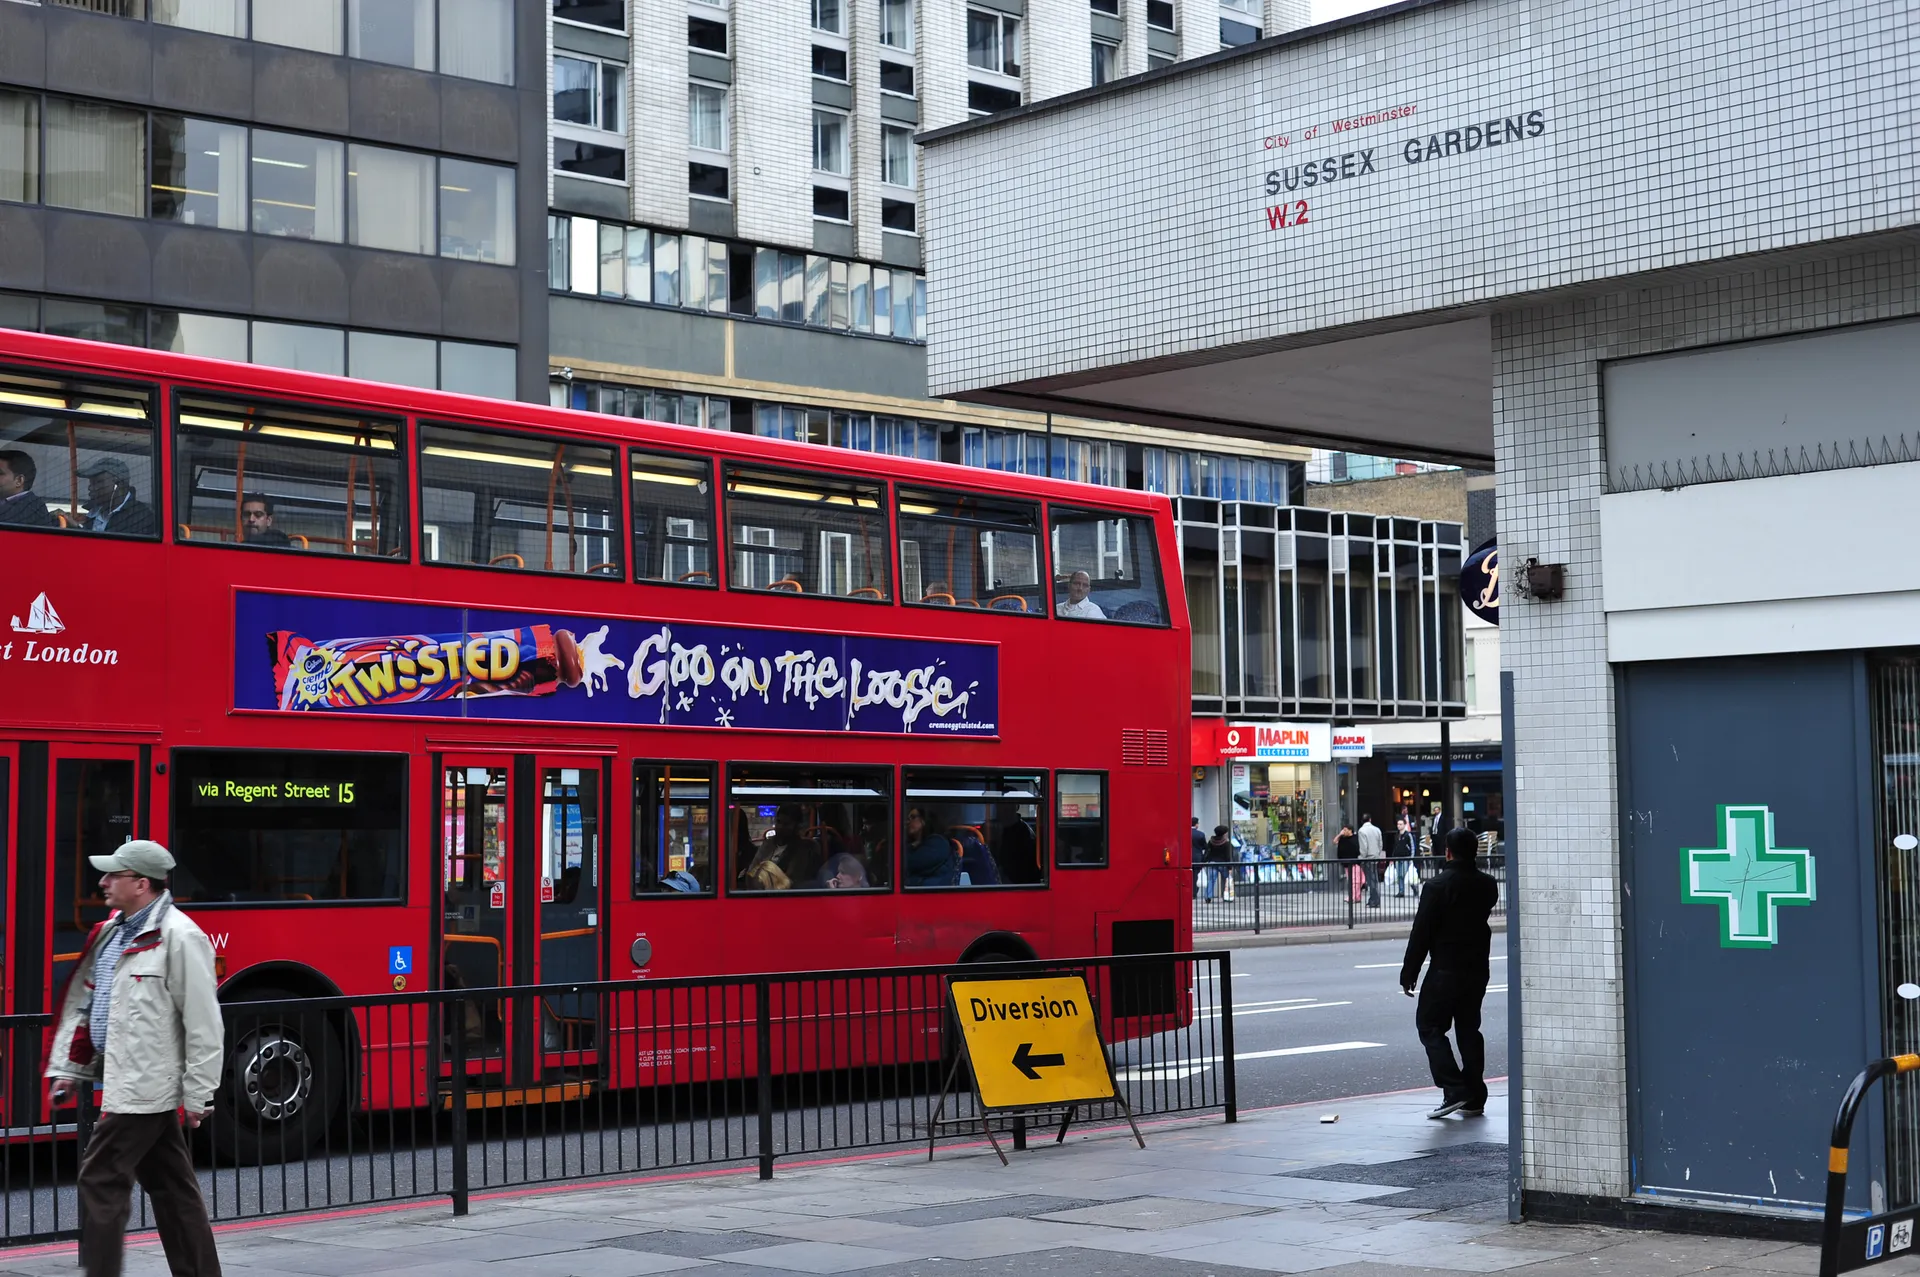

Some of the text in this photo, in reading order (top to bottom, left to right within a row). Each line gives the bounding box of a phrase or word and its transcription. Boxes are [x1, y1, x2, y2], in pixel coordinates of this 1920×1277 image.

[1264, 103, 1417, 150] City of Westminster
[1265, 110, 1545, 196] SUSSEX GARDENS
[1266, 199, 1309, 231] W.2
[22, 640, 119, 666] London
[302, 660, 332, 684] creme
[305, 678, 328, 696] egg
[928, 720, 995, 731] cremeeggtwisted.com
[1257, 727, 1309, 747] MAPLIN
[1219, 746, 1248, 755] vodafone
[1258, 748, 1309, 757] ELECTRONICS
[1332, 735, 1366, 746] MAPLIN
[198, 780, 354, 804] via Regent Street 15
[969, 995, 1079, 1022] Diversion
